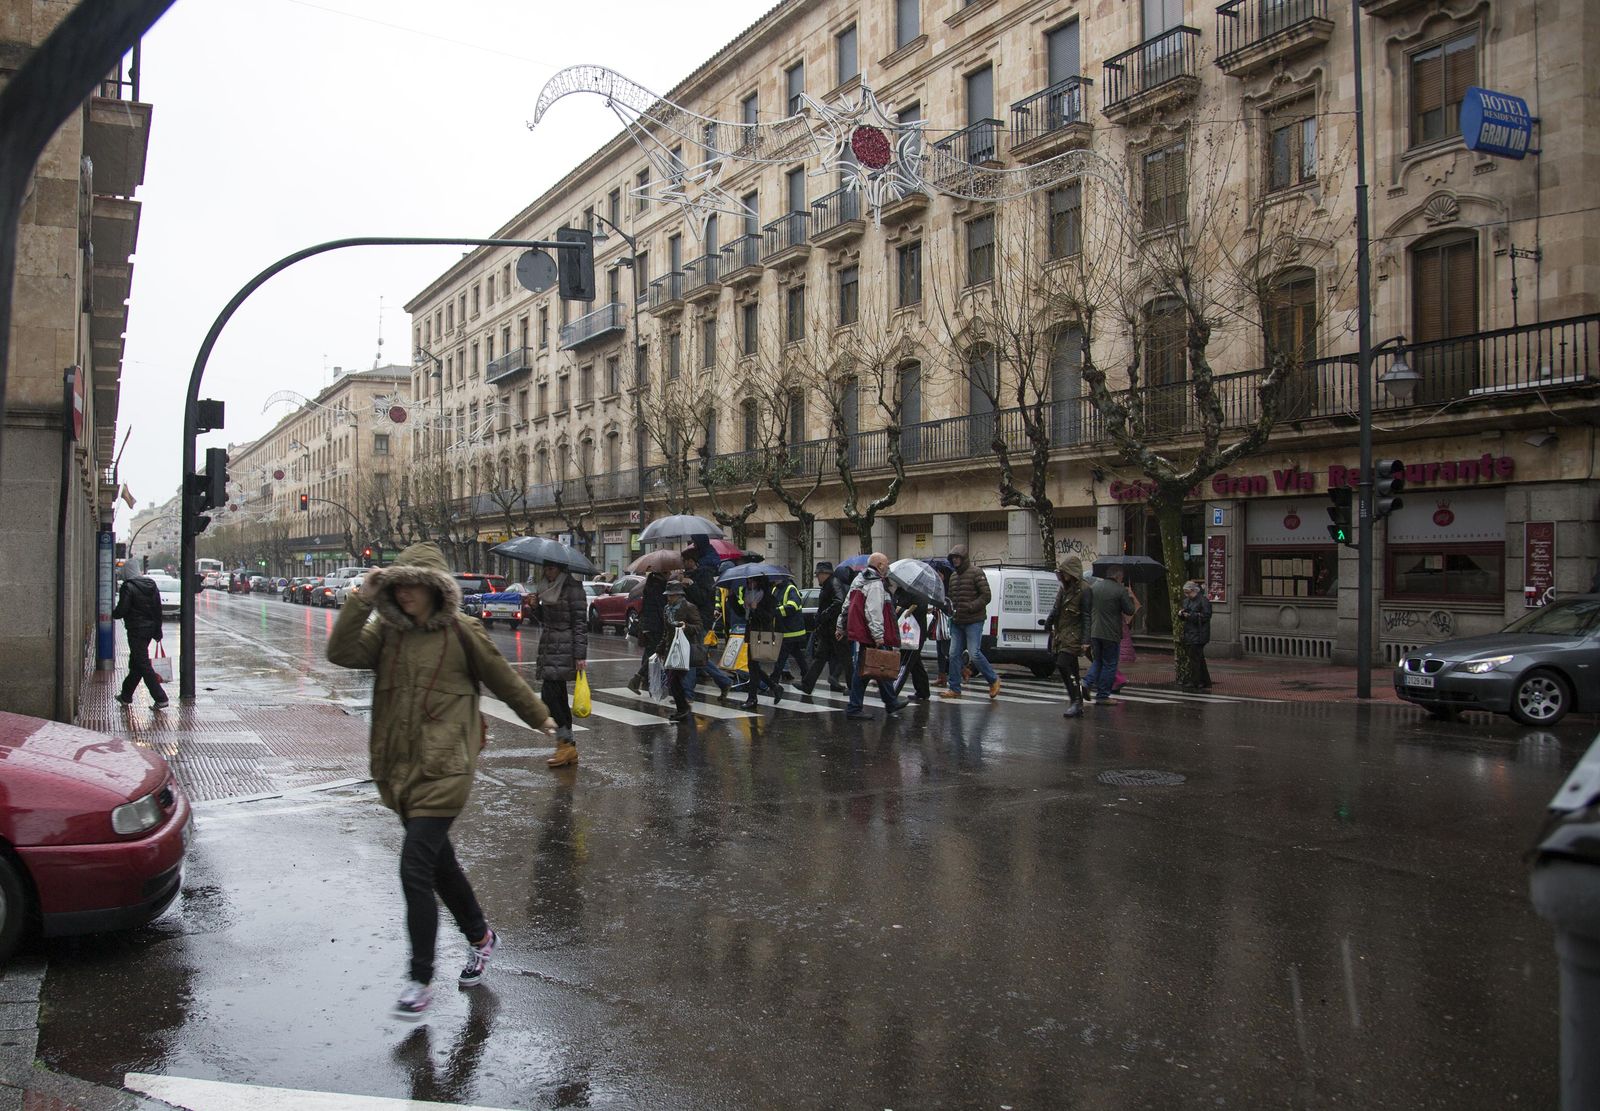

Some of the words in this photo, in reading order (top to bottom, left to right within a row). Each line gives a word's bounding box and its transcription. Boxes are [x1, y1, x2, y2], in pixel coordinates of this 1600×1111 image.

[1479, 93, 1527, 117] HOTEL
[1480, 122, 1509, 146] GRAN
[1211, 472, 1268, 495] Gran
